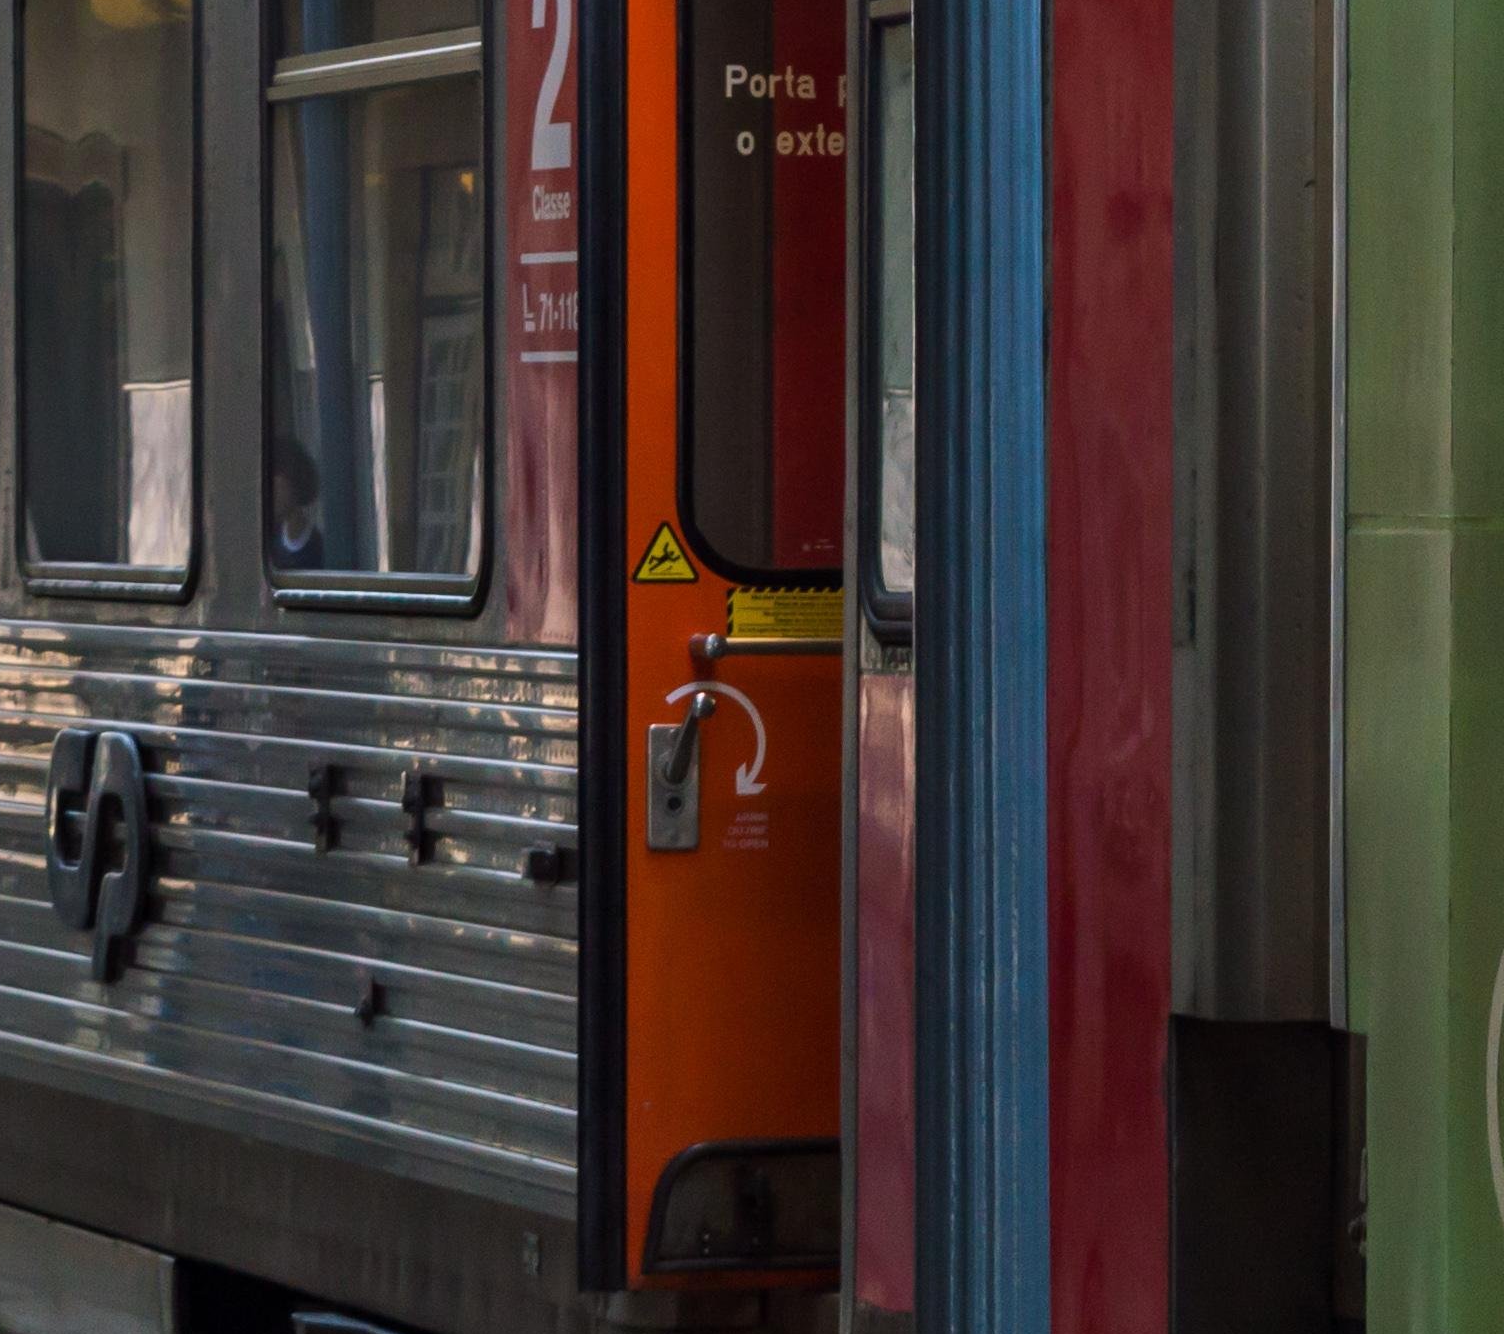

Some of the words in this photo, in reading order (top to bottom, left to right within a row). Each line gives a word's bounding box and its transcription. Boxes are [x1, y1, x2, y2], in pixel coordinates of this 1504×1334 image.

[726, 64, 817, 99] Porta
[736, 130, 755, 157] o
[532, 184, 571, 221] Classe
